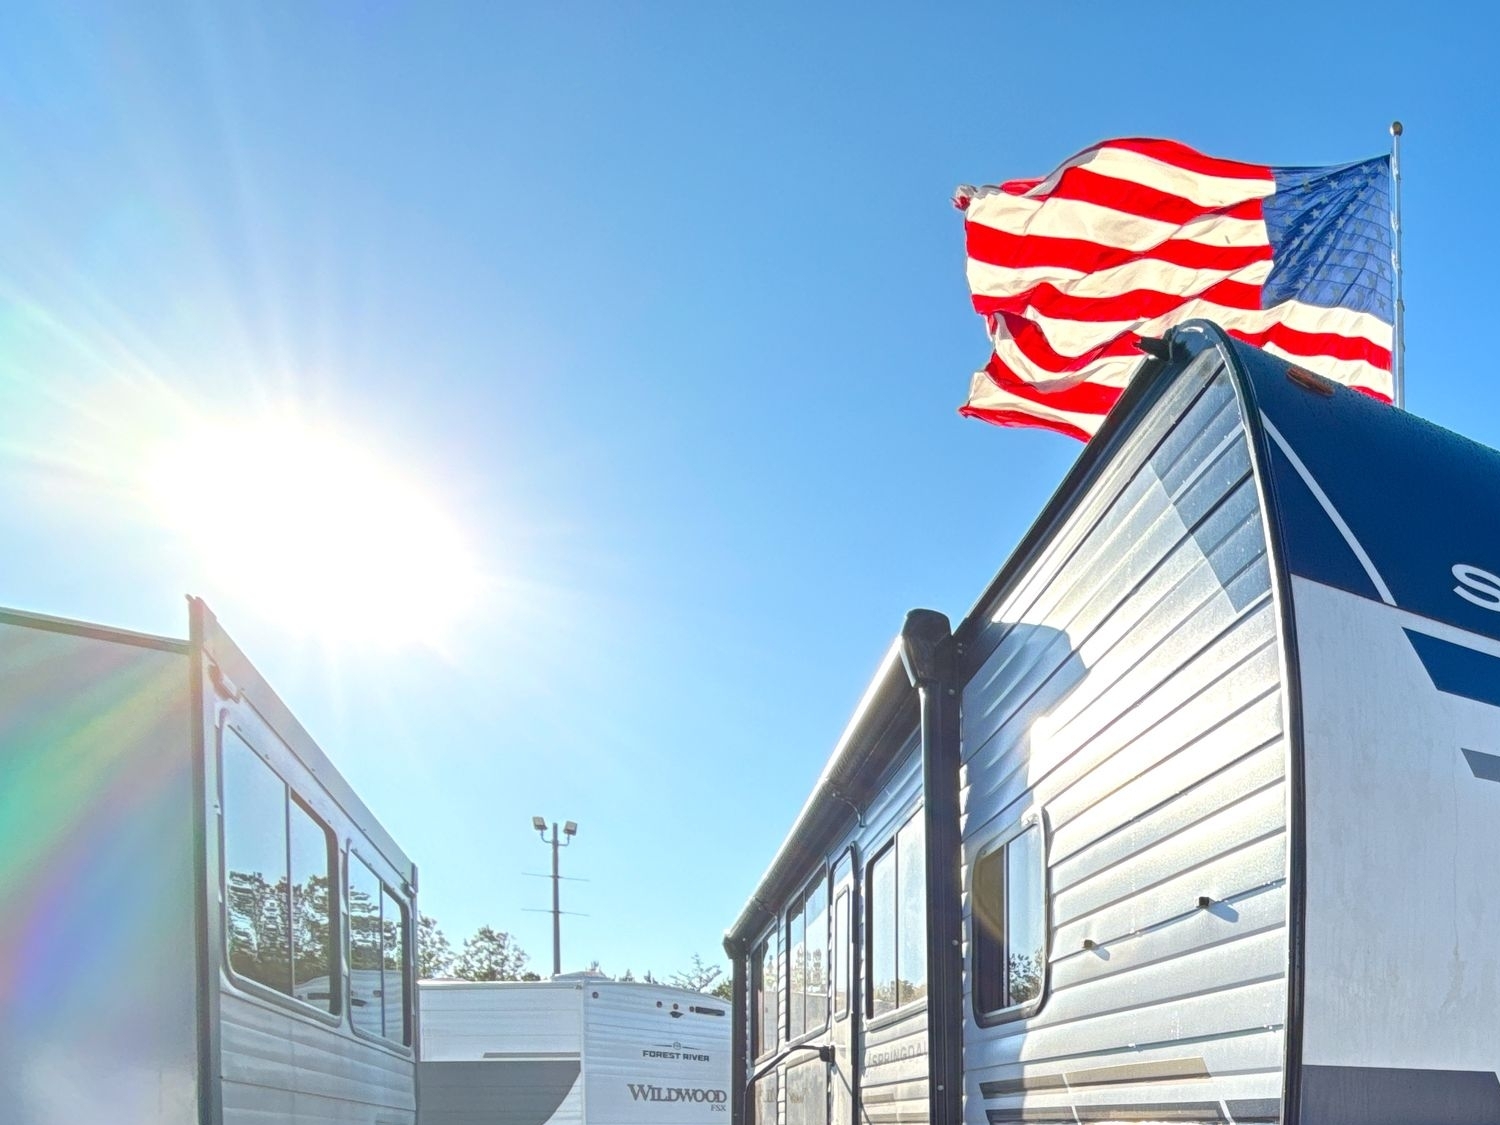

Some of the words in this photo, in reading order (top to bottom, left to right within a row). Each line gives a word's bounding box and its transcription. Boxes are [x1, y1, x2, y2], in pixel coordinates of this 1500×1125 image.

[643, 1050, 680, 1060] FOREST
[683, 1053, 710, 1061] RIVER
[872, 1040, 927, 1065] SPRINGDAL
[627, 1084, 727, 1103] WILDWOOD
